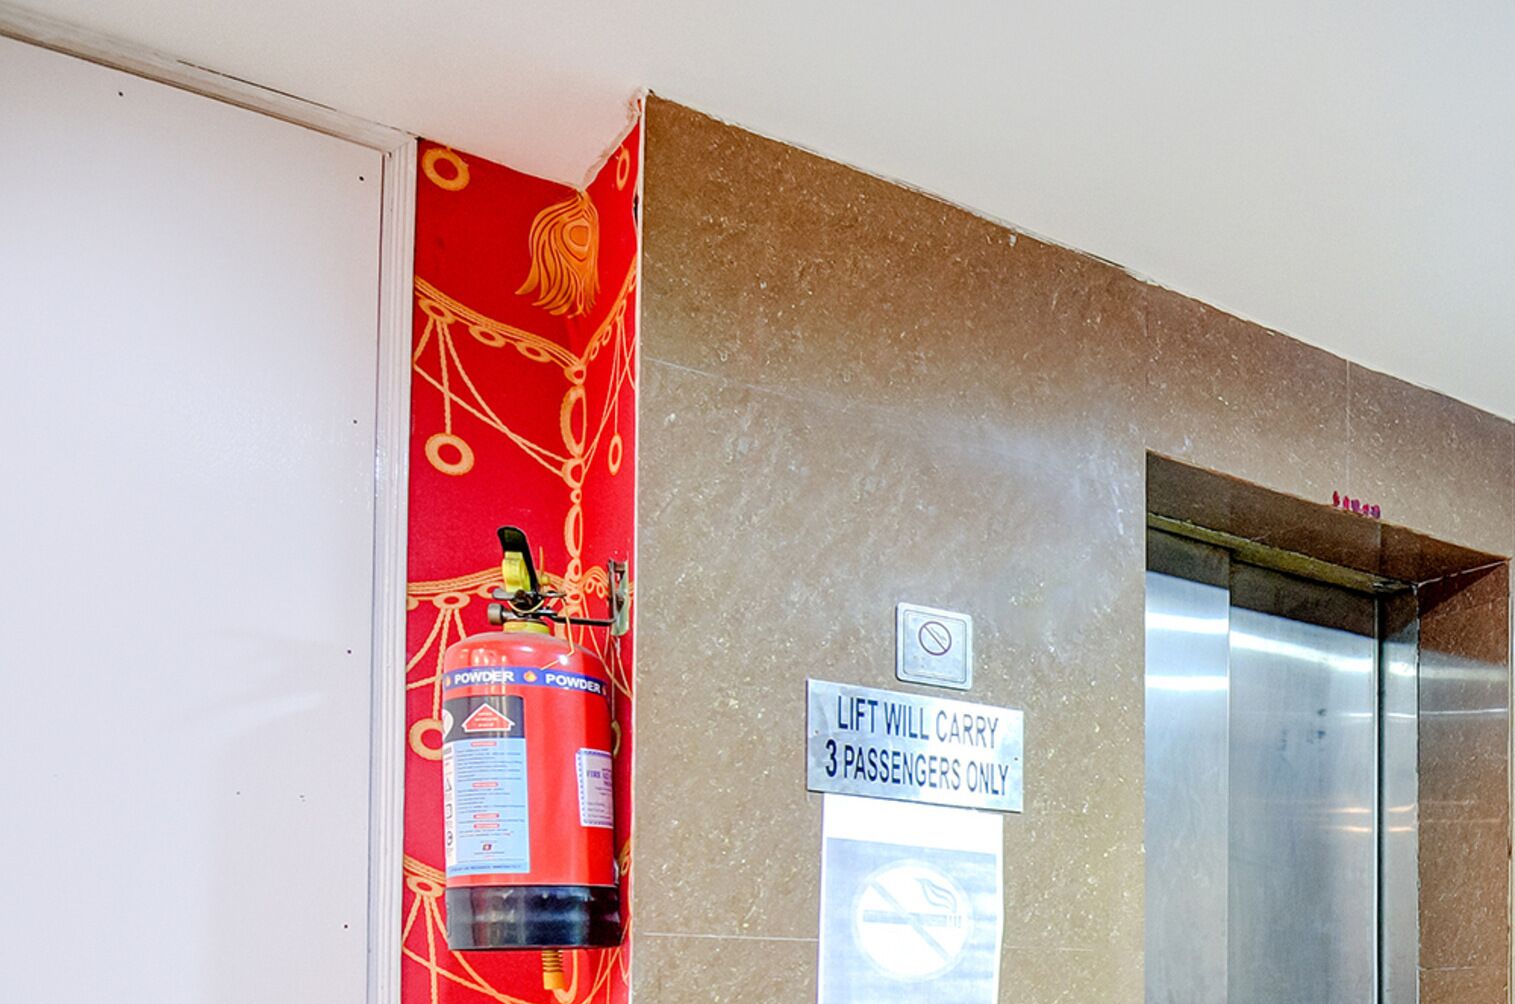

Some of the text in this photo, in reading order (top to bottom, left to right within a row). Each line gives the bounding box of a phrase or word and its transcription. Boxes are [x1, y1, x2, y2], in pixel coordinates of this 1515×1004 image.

[454, 670, 601, 694] POWDER POWDER
[837, 695, 999, 749] LIFT WILL CARRY
[825, 738, 1009, 796] 3 PASSENGERS ONLY
